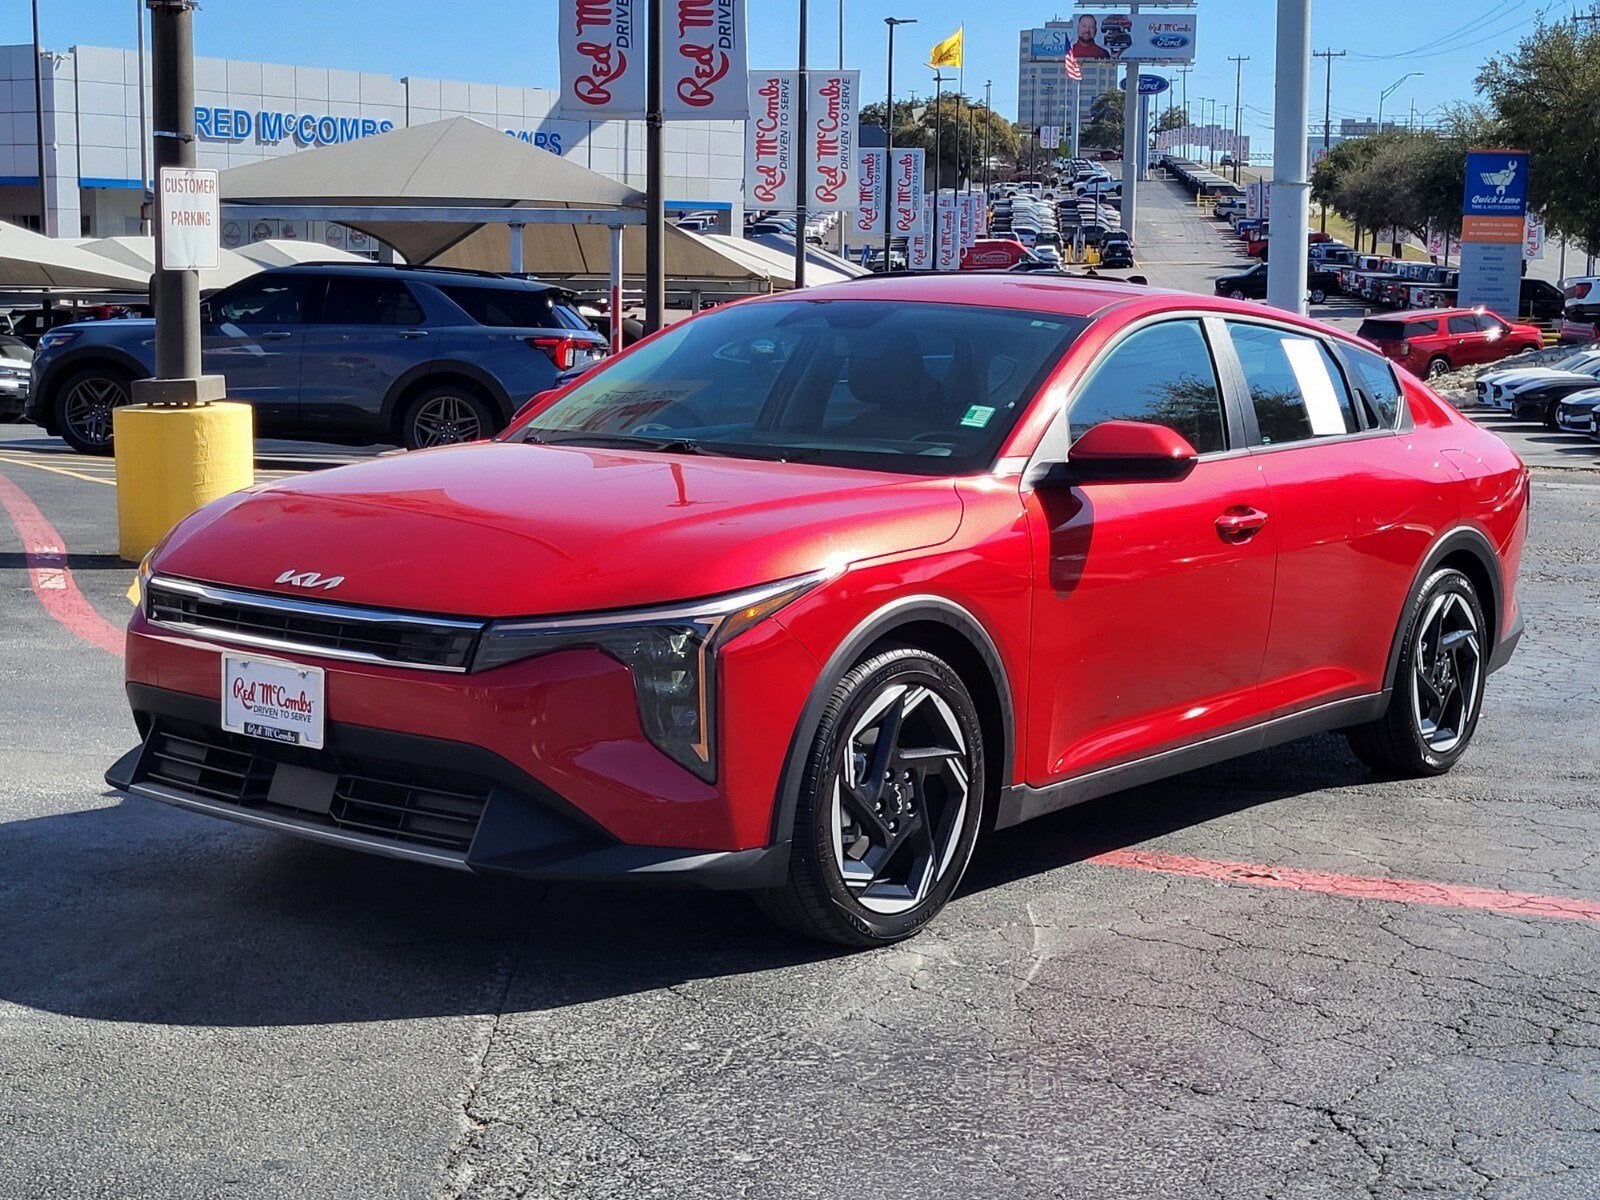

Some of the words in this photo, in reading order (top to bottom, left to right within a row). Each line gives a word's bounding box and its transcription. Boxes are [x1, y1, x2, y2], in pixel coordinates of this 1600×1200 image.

[1148, 23, 1162, 34] Red
[1156, 36, 1182, 47] Ford
[574, 42, 627, 105] Red
[677, 44, 729, 107] Red
[781, 78, 789, 110] SERVE
[842, 78, 851, 110] SERVE
[194, 107, 251, 139] RED
[756, 78, 780, 162] McCombs
[781, 113, 789, 127] TO
[816, 78, 840, 162] McCombs
[841, 113, 849, 127] TO
[504, 130, 562, 156] RS
[780, 130, 788, 169] DRIVEN
[841, 130, 849, 169] DRIVEN
[165, 178, 215, 194] CUSTOMER
[754, 165, 786, 202] Red
[815, 165, 847, 202] Red
[859, 153, 875, 205] McCombs
[875, 174, 881, 184] TO
[897, 153, 912, 206] McCombs
[913, 175, 919, 184] TO
[1472, 195, 1498, 204] Quick
[1499, 195, 1521, 204] Lane
[171, 211, 211, 227] PARKING
[858, 207, 878, 230] Red
[896, 208, 917, 231] Red
[941, 210, 952, 246] McCombs
[913, 249, 927, 265] Red
[940, 249, 954, 265] Red
[1526, 240, 1540, 257] Red
[233, 677, 256, 710] Red
[258, 682, 312, 713] McCombs
[253, 705, 278, 716] DRIVEN
[280, 710, 289, 718] TO
[291, 712, 312, 723] SERVE
[248, 724, 262, 735] Red
[265, 727, 296, 742] McCombs
